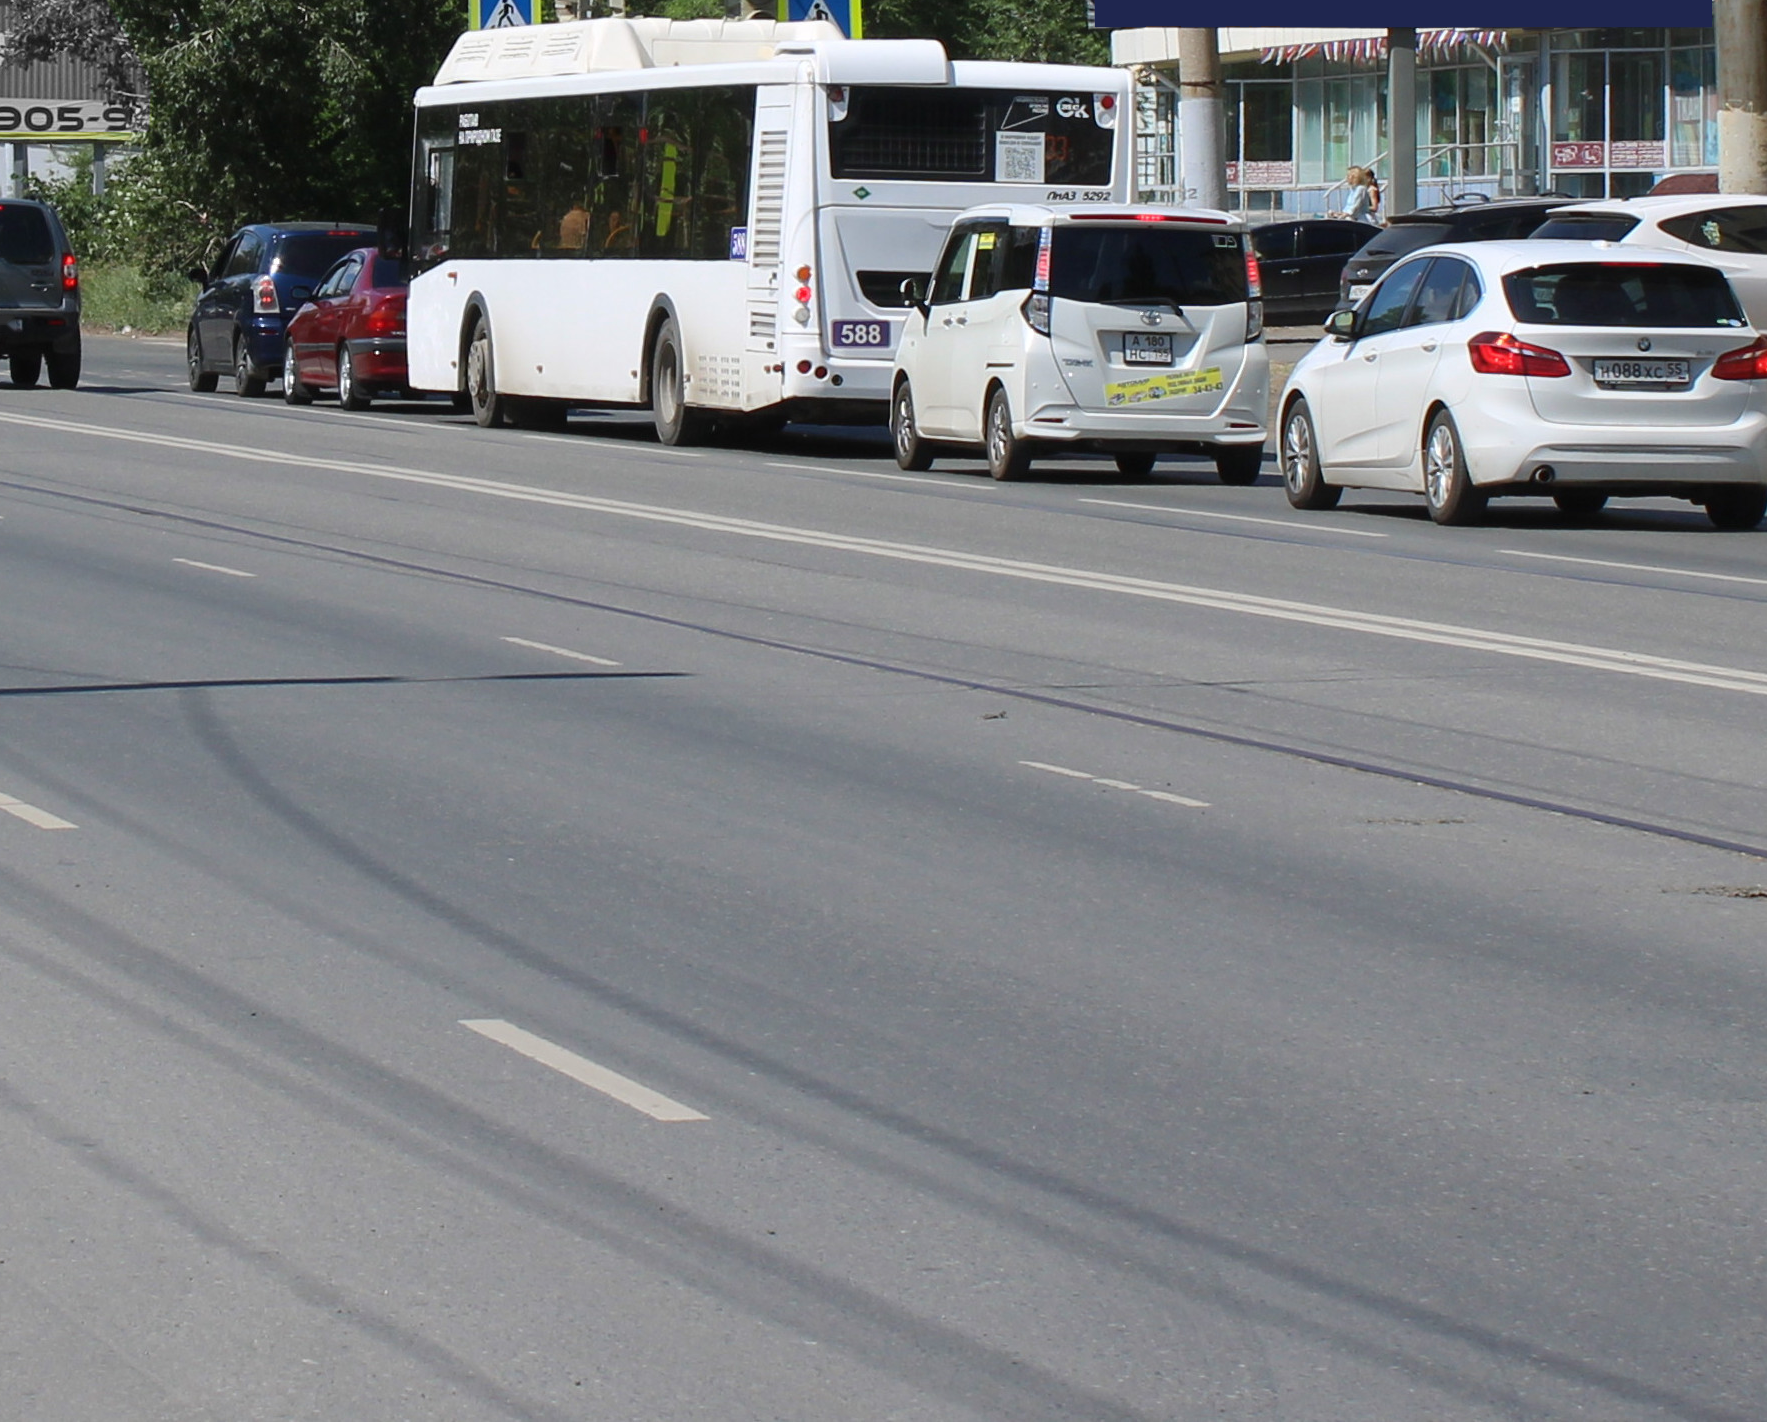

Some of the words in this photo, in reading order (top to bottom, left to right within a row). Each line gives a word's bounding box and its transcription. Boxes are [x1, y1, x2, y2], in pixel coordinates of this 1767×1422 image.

[1082, 191, 1111, 201] 5292
[840, 324, 881, 344] 588
[1146, 336, 1165, 347] 180
[1667, 363, 1682, 375] 55
